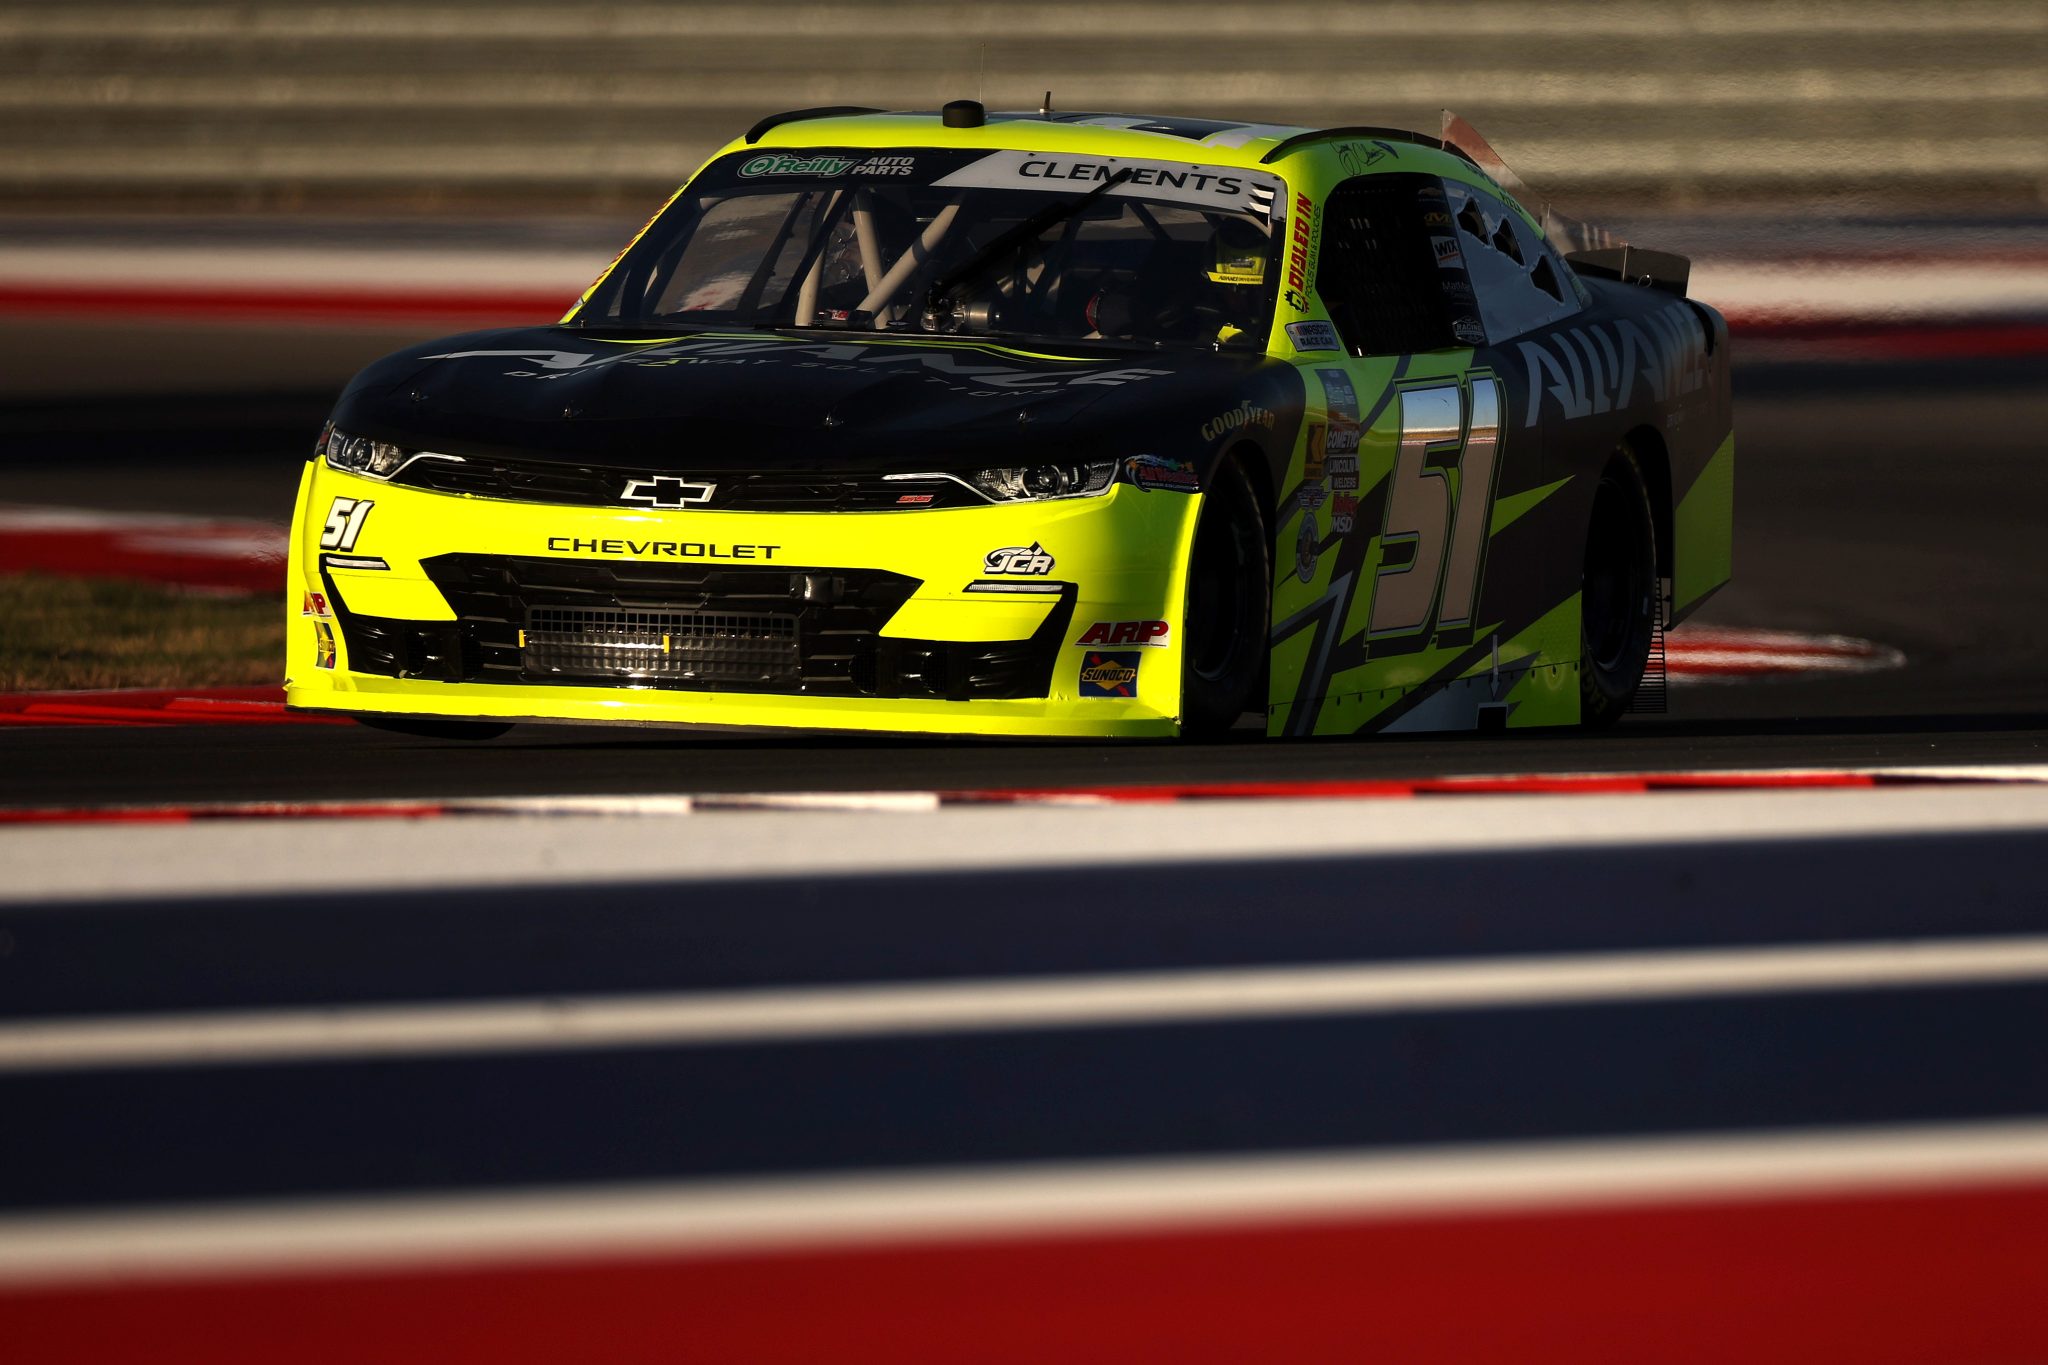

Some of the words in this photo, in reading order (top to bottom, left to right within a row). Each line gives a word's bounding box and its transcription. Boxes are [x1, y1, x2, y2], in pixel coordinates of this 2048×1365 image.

[741, 155, 857, 177] O'Reilly
[851, 165, 914, 176] PARTS
[863, 156, 915, 166] AUTO
[1018, 160, 1242, 195] CLEMENTS
[1296, 191, 1312, 219] IN
[1434, 239, 1459, 257] WIX
[1300, 336, 1321, 347] RACE
[1326, 430, 1360, 449] COMETIC
[1366, 368, 1505, 650] 51
[319, 495, 375, 552] 51
[1331, 516, 1353, 532] MSD
[548, 537, 781, 559] CHEVROLET
[1077, 620, 1169, 644] ARP
[1083, 668, 1134, 681] SUNOCO
